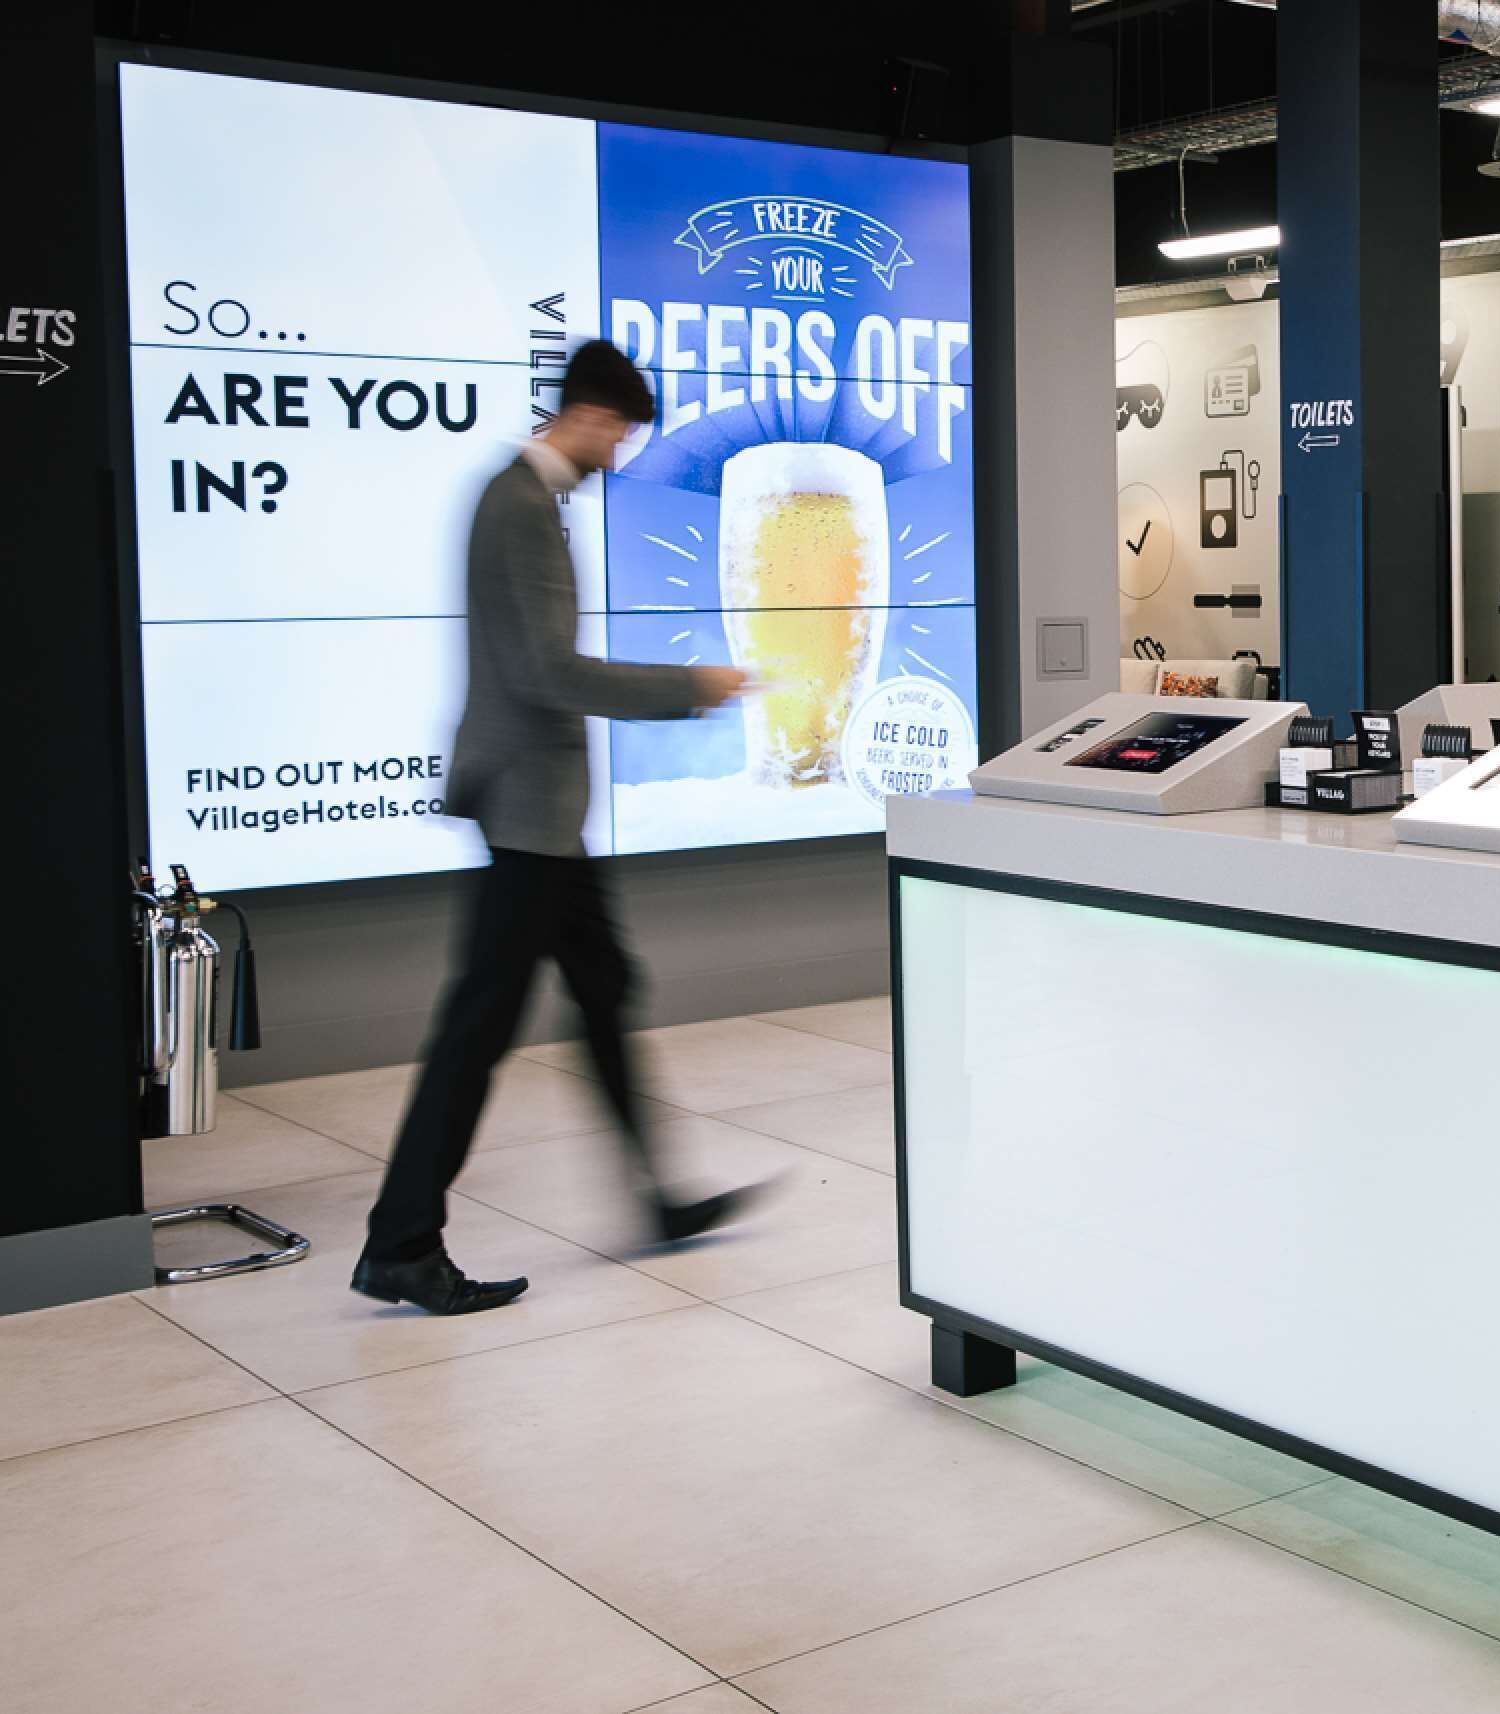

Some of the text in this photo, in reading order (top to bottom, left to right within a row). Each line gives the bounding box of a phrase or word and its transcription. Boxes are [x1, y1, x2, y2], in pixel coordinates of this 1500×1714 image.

[753, 201, 841, 238] FREEZE
[771, 255, 825, 293] YOUR
[0, 307, 76, 347] ETS
[163, 279, 306, 342] So...
[164, 371, 478, 433] ARE YOU
[856, 314, 969, 465] OFF
[1290, 400, 1353, 428] TOILETS
[171, 459, 288, 514] IN?
[873, 721, 949, 749] ICE COLD
[187, 755, 443, 793] FIND OUT MORE
[881, 770, 933, 793] FROSTED
[186, 796, 444, 832] VillageHotels.co
